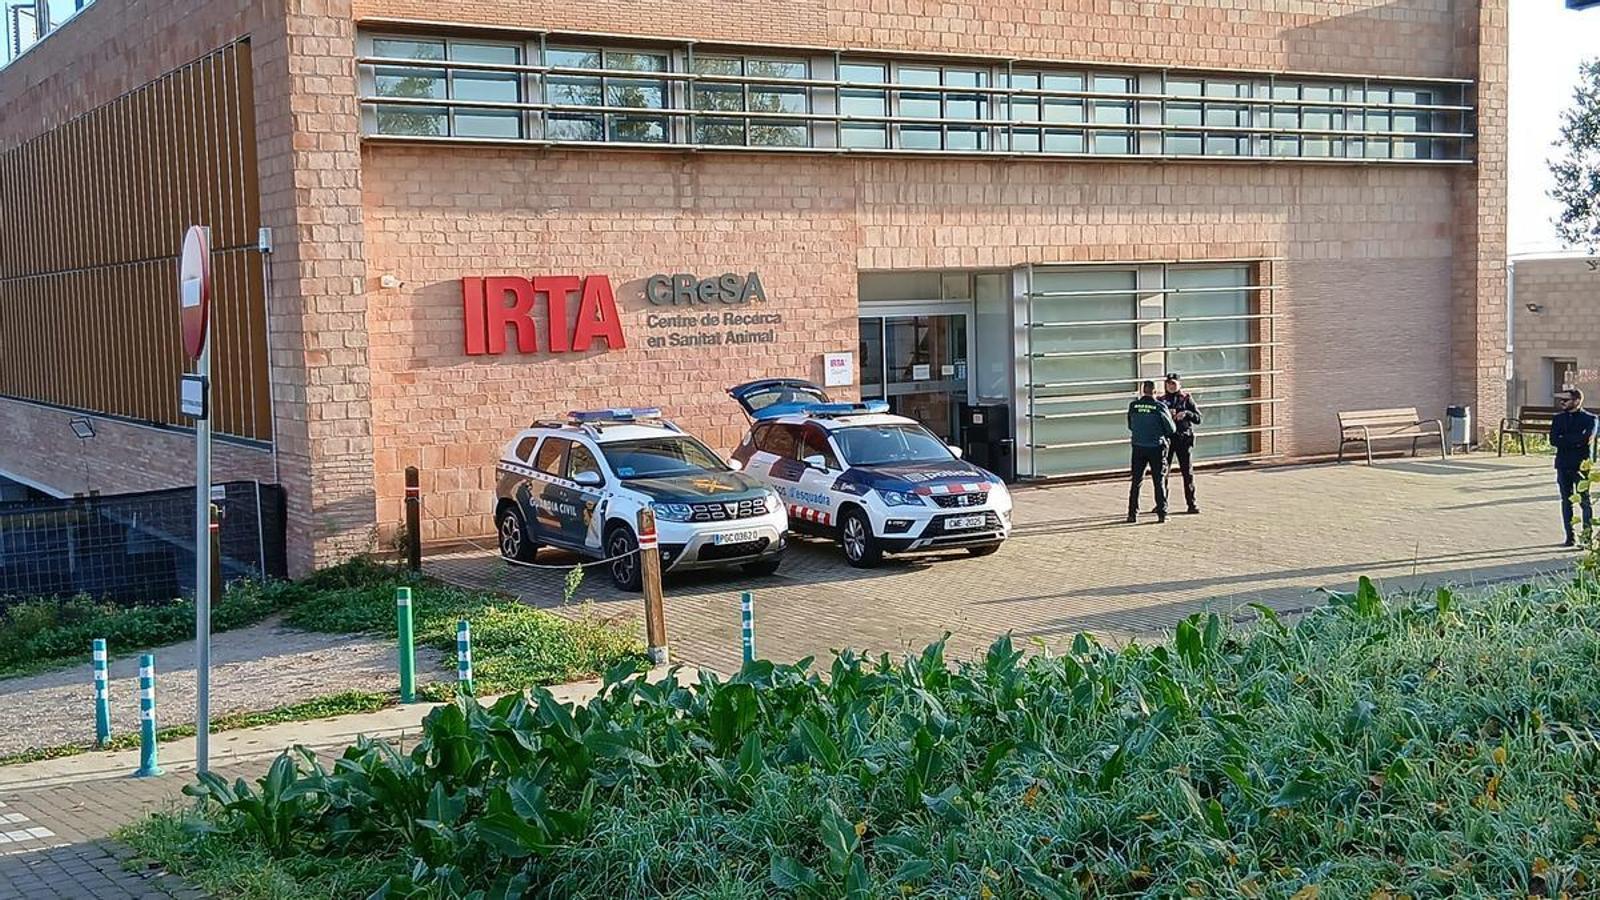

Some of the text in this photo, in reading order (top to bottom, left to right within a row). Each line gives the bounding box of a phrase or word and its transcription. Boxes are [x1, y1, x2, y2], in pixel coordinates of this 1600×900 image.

[647, 271, 767, 306] CReSA
[462, 275, 626, 355] IRTA
[647, 312, 782, 329] Centre de Recerca
[647, 329, 774, 347] en Sanitat Animal
[559, 502, 577, 517] CIVIL
